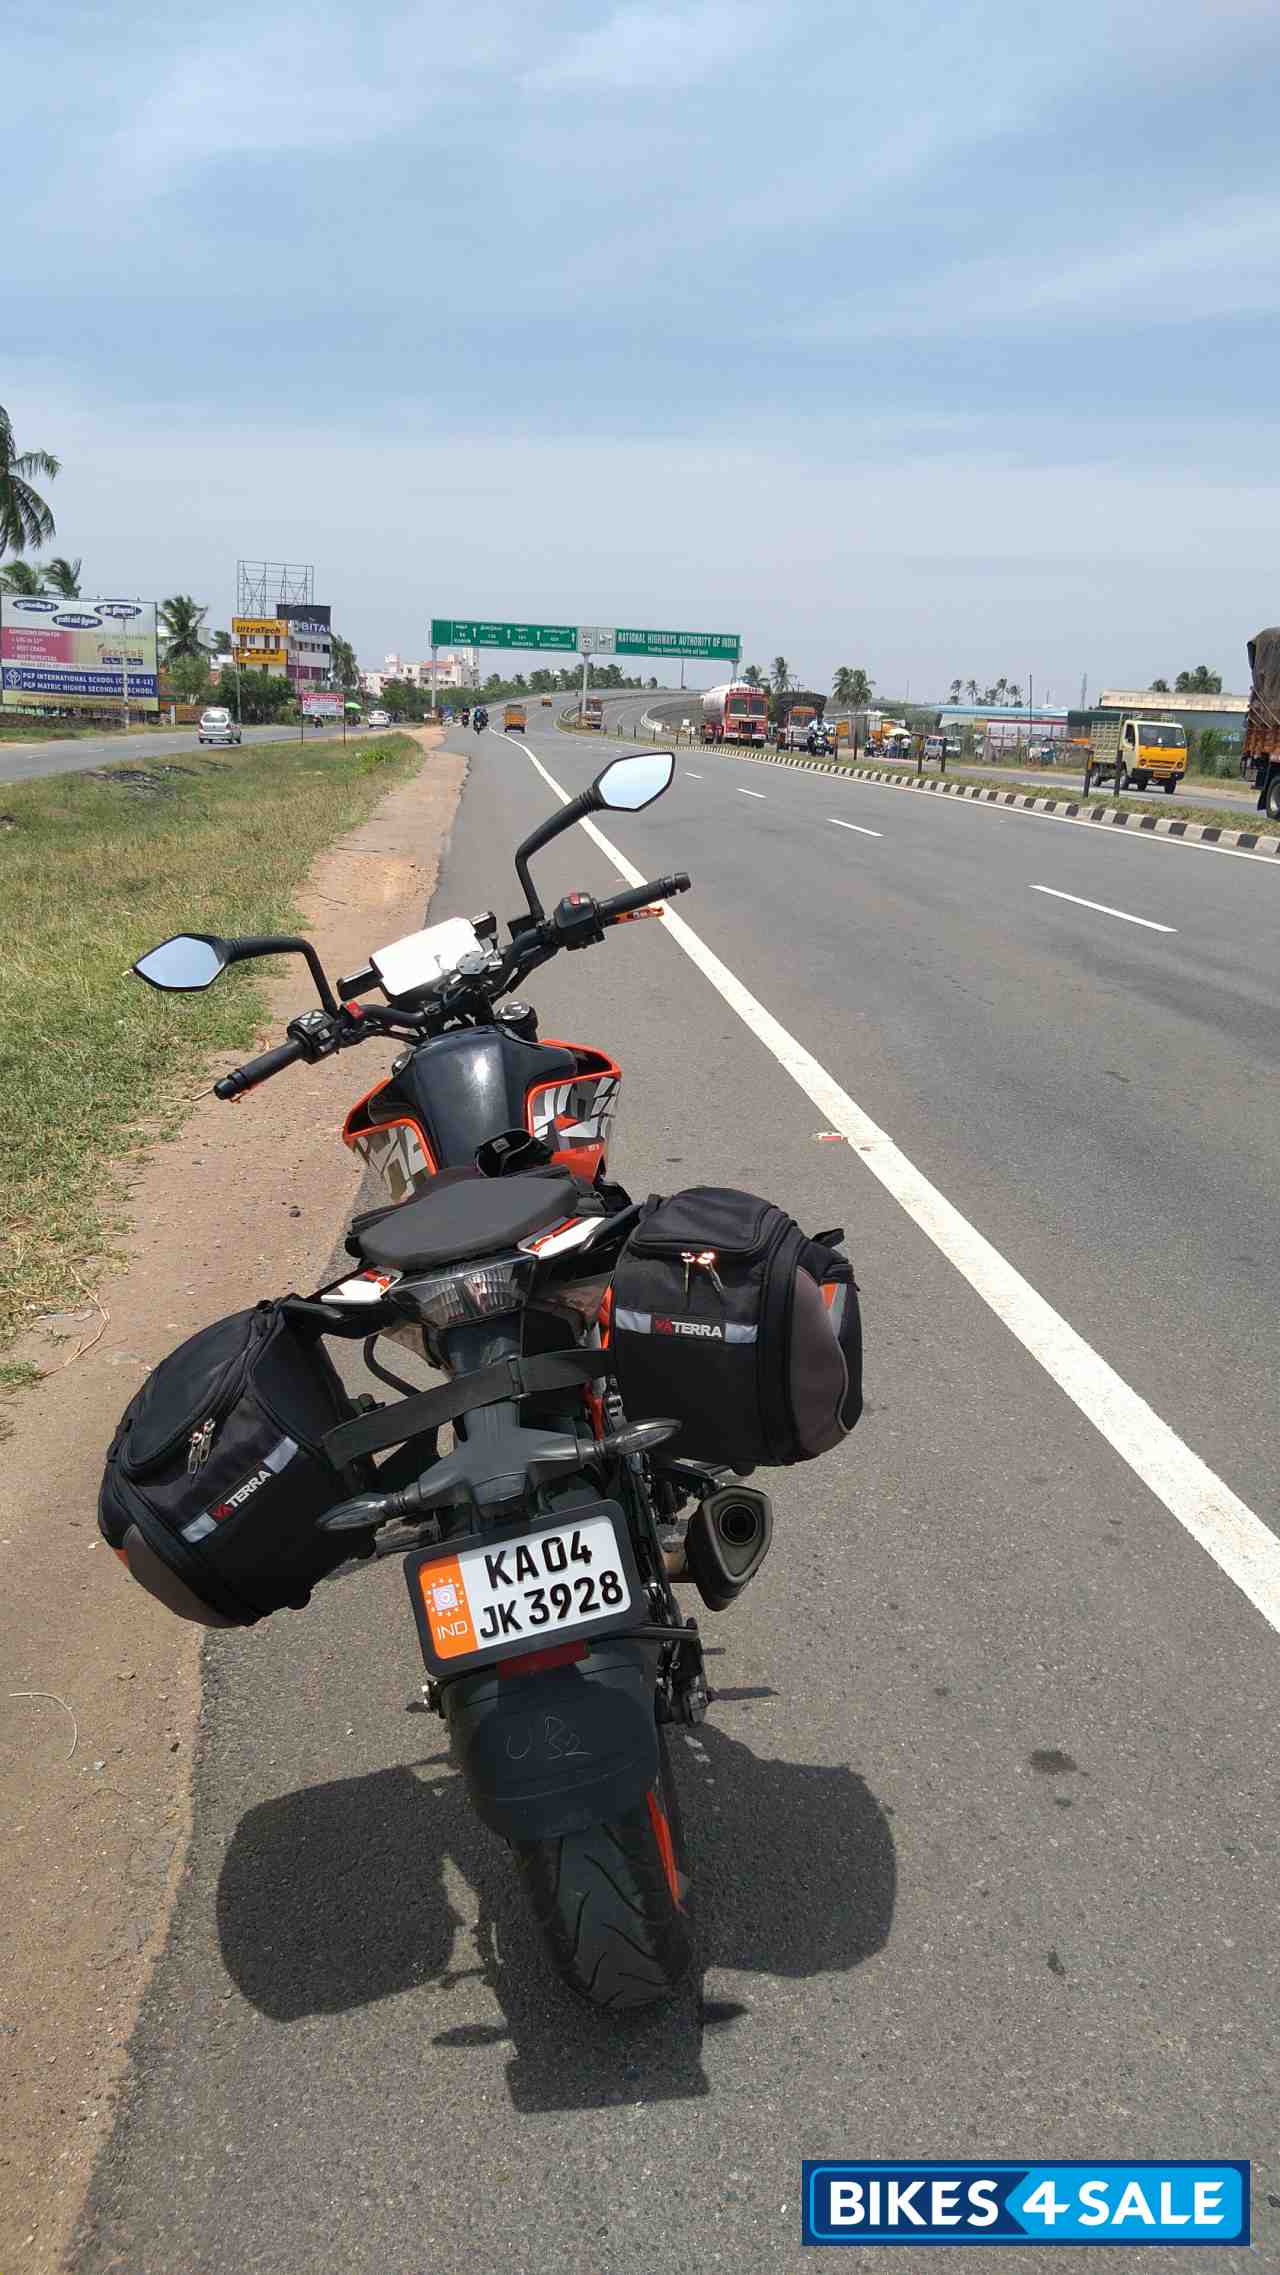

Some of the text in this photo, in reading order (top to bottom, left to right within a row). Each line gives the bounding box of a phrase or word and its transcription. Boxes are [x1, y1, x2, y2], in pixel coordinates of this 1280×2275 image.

[618, 631, 646, 643] NATIONAL
[648, 633, 677, 645] HIGHWAYS
[678, 635, 711, 647] AUTHORITY
[721, 638, 737, 648] INDIA
[37, 673, 87, 683] INTERNATIONAL
[88, 676, 114, 685] SCHOOL
[63, 684, 87, 692] HIGHER
[127, 687, 153, 695] SCHOOL
[436, 1621, 468, 1640] IND
